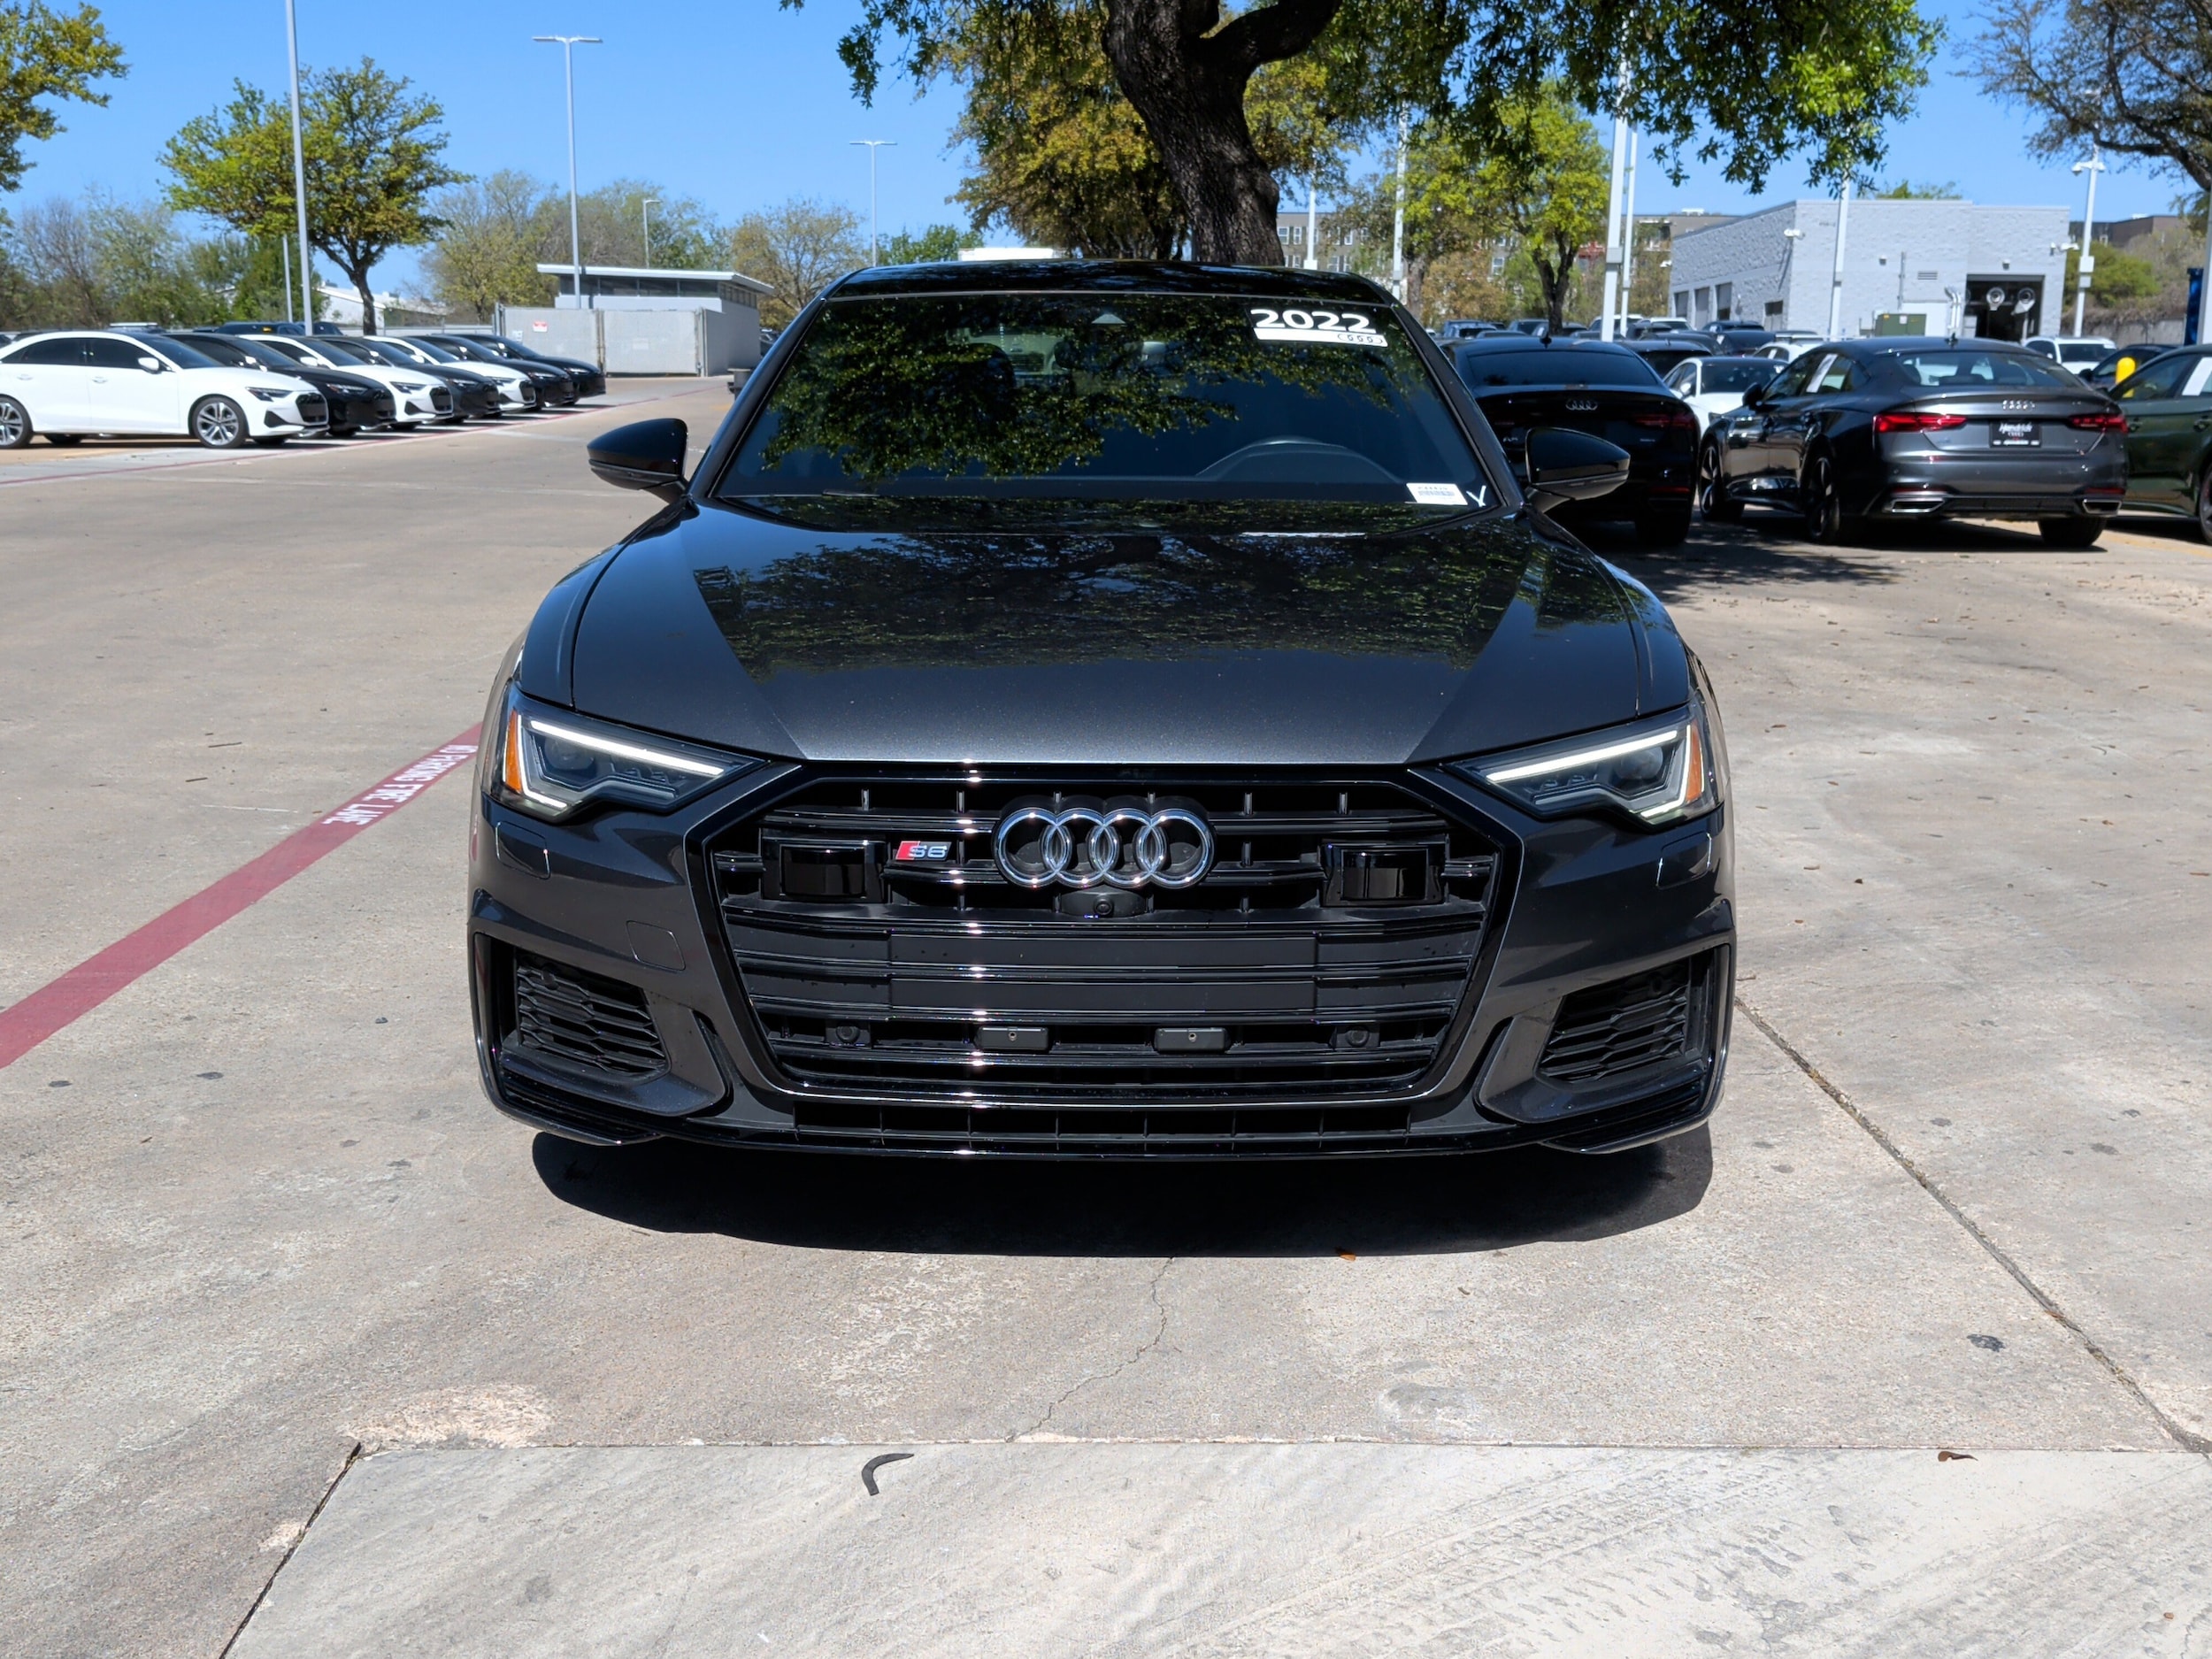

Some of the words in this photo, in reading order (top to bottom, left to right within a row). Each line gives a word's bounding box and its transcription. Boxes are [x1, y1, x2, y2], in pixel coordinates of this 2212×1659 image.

[1250, 309, 1377, 334] 2022
[394, 755, 468, 781] PARKING
[362, 784, 425, 803] FIRE
[321, 803, 394, 826] LANE
[908, 845, 947, 857] S6
